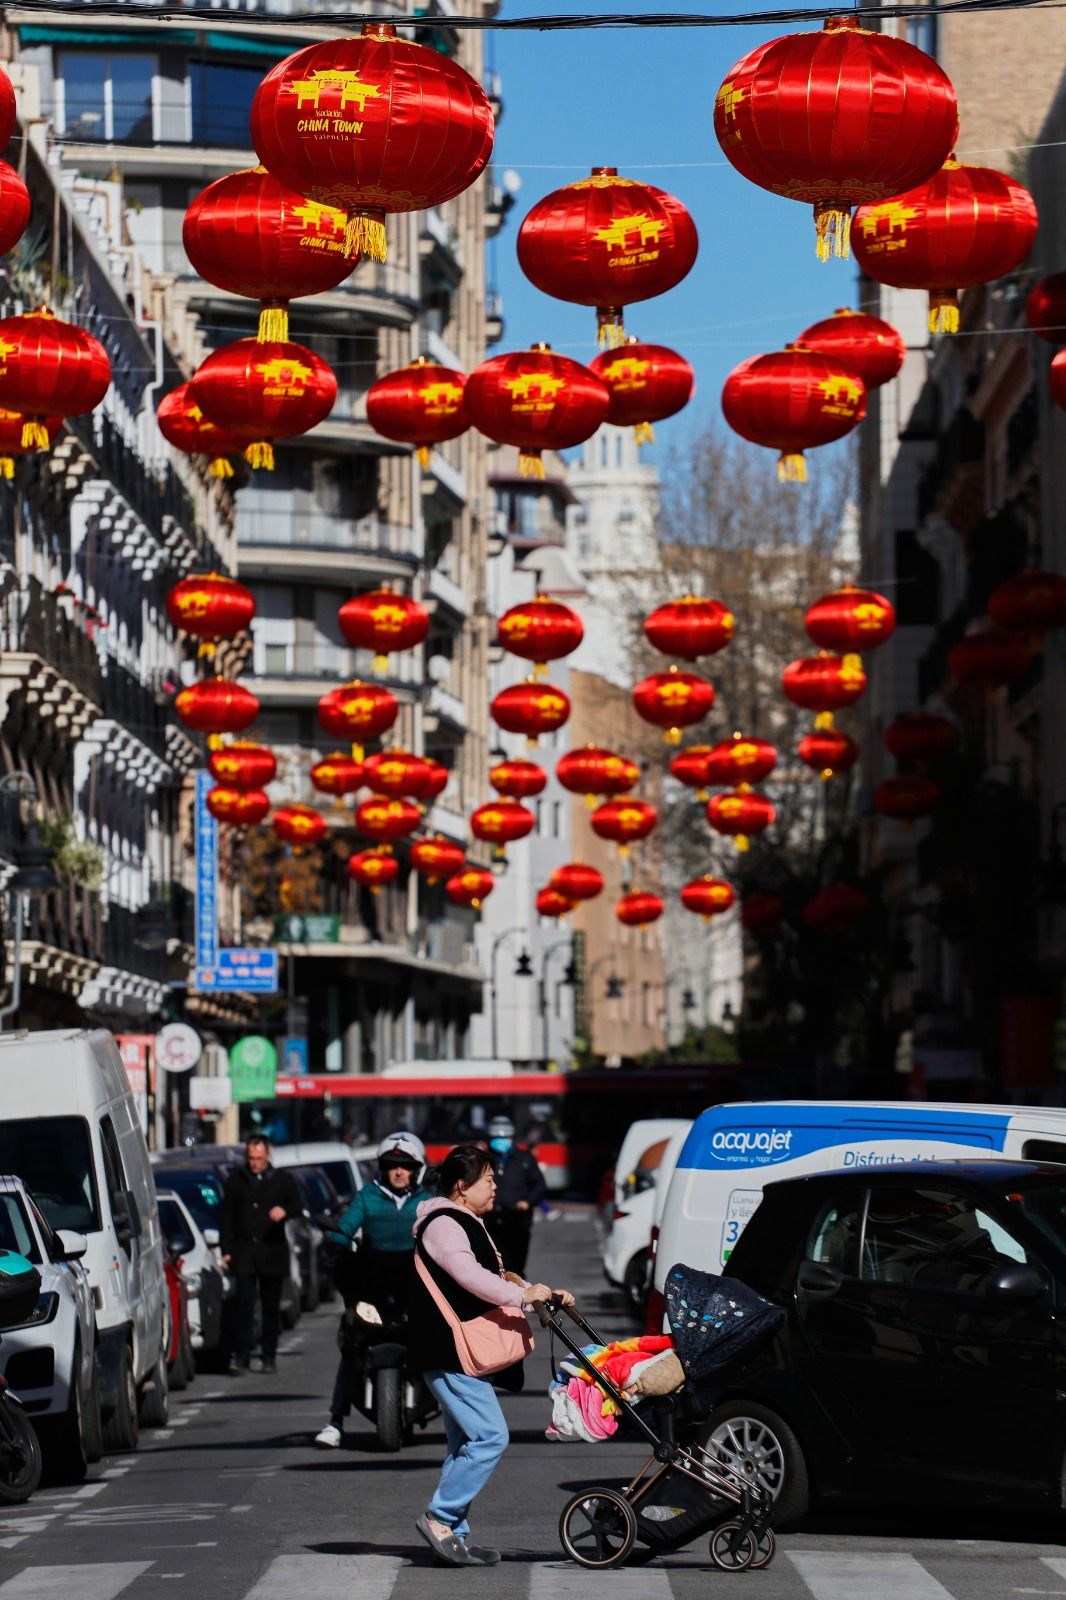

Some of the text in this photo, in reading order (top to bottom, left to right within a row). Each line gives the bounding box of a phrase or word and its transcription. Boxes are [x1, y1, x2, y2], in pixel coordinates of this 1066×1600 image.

[297, 119, 364, 133] CHINA TOWN
[300, 236, 327, 249] CHINA
[712, 1128, 792, 1153] acquajet
